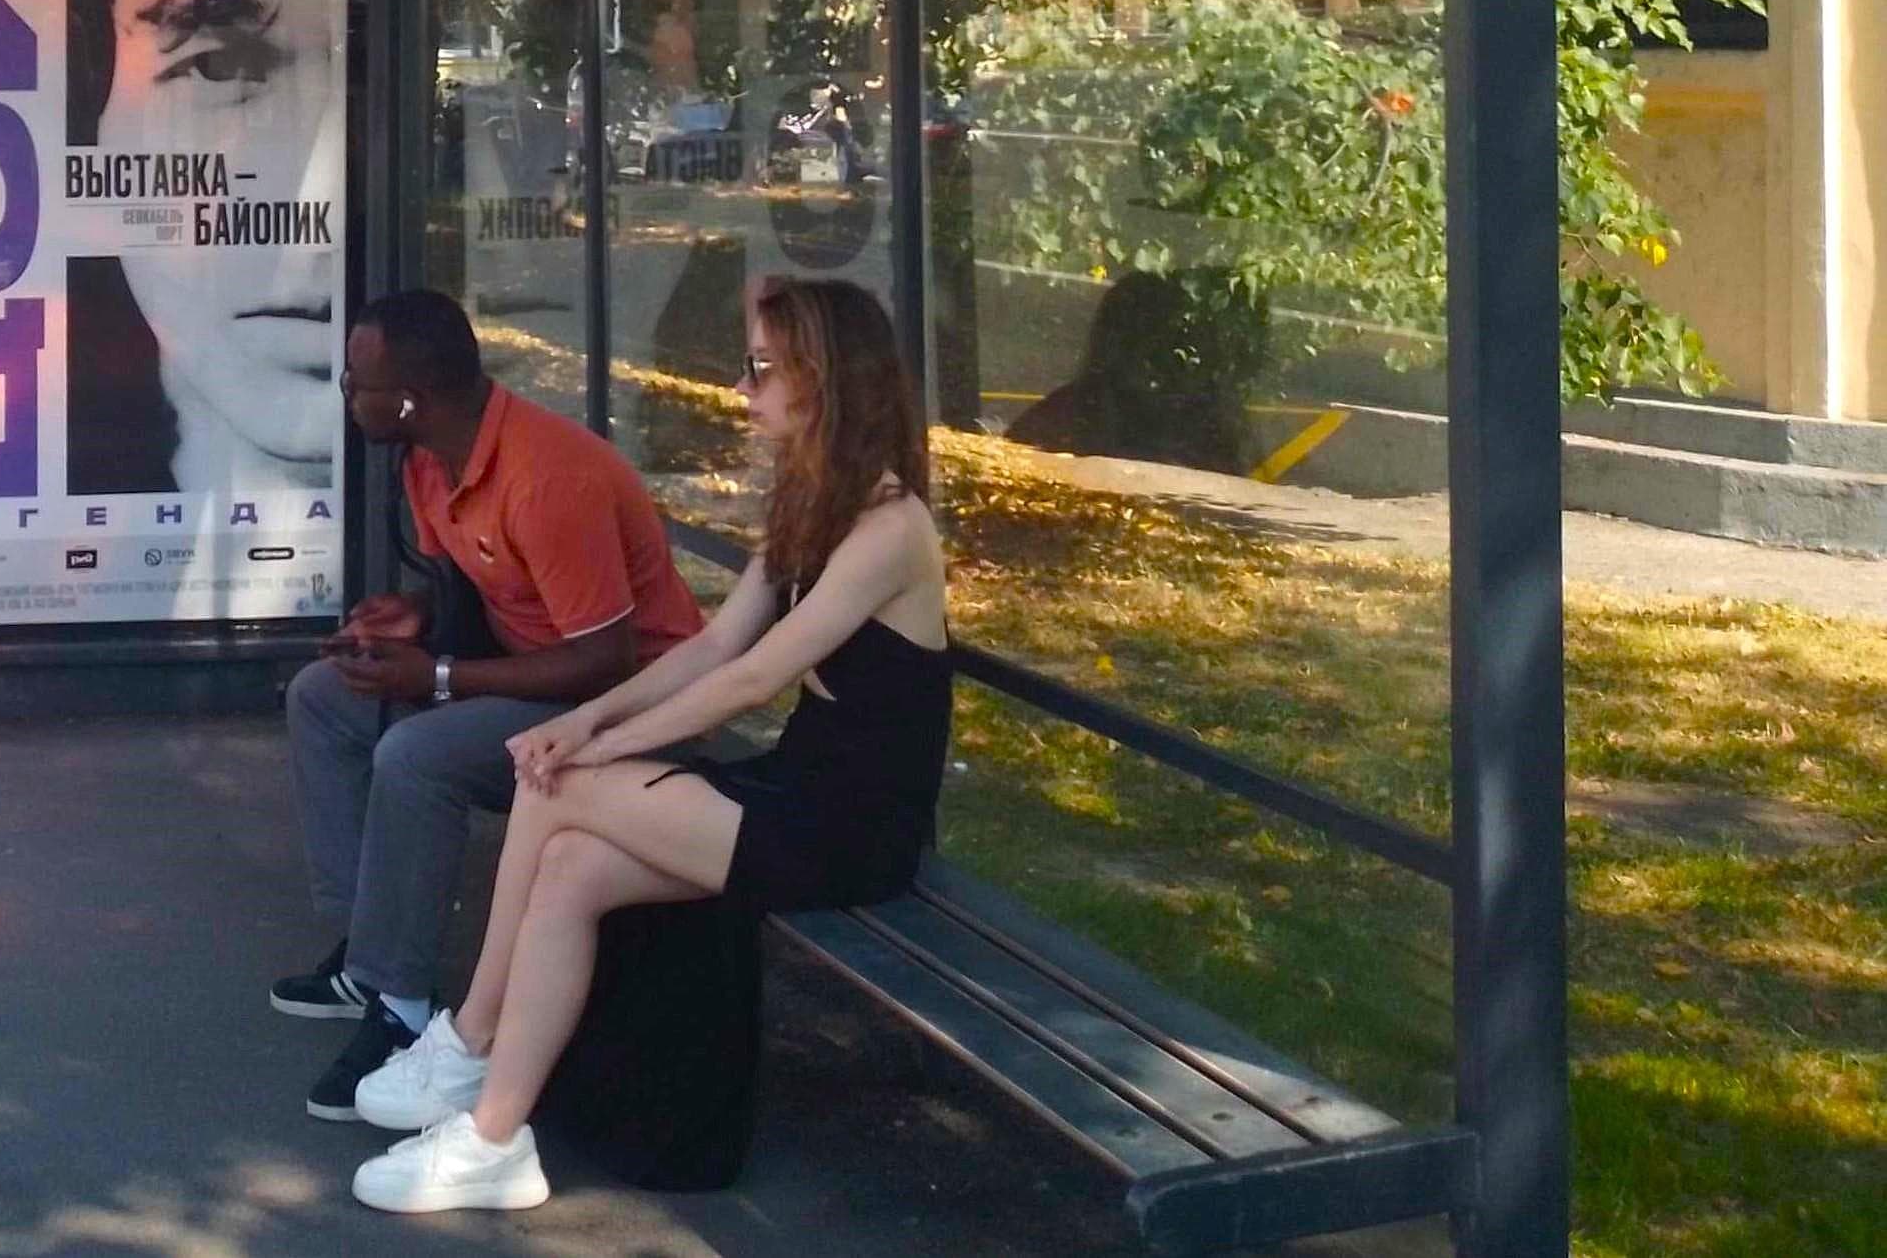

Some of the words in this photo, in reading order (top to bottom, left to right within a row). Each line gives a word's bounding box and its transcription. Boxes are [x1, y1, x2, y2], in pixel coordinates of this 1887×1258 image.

[65, 153, 229, 199] ВЫСТАВКА
[194, 197, 332, 246] БАЙОПИК
[311, 573, 333, 597] 12+
